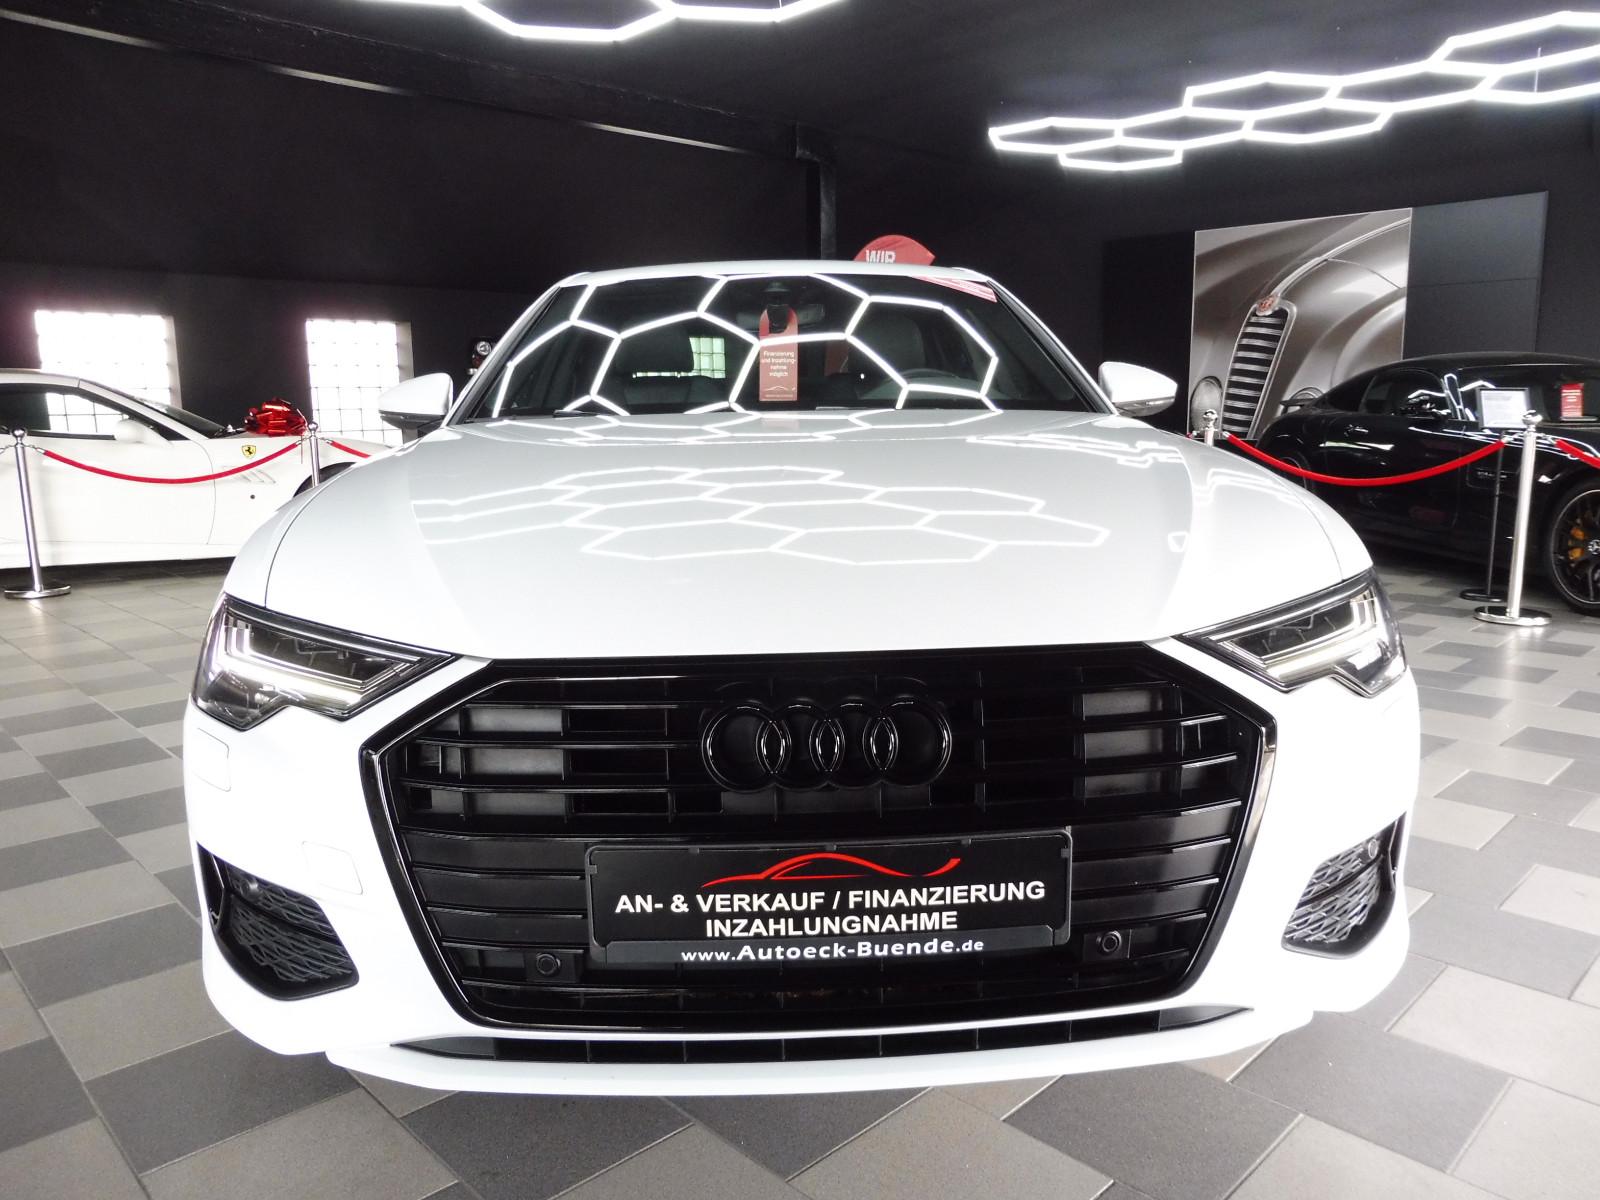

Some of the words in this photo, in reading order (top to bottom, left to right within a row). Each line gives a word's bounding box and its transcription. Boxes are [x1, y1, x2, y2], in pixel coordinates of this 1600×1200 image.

[865, 249, 896, 263] WIR
[614, 894, 663, 913] AN-
[670, 894, 689, 912] &
[695, 891, 825, 913] VERKAUF
[832, 891, 841, 909] /
[848, 880, 1045, 909] FINANZIERUNG
[706, 910, 958, 937] INZAHLUNGNAHME
[680, 938, 984, 961] www.Autoeck-Buende.de
